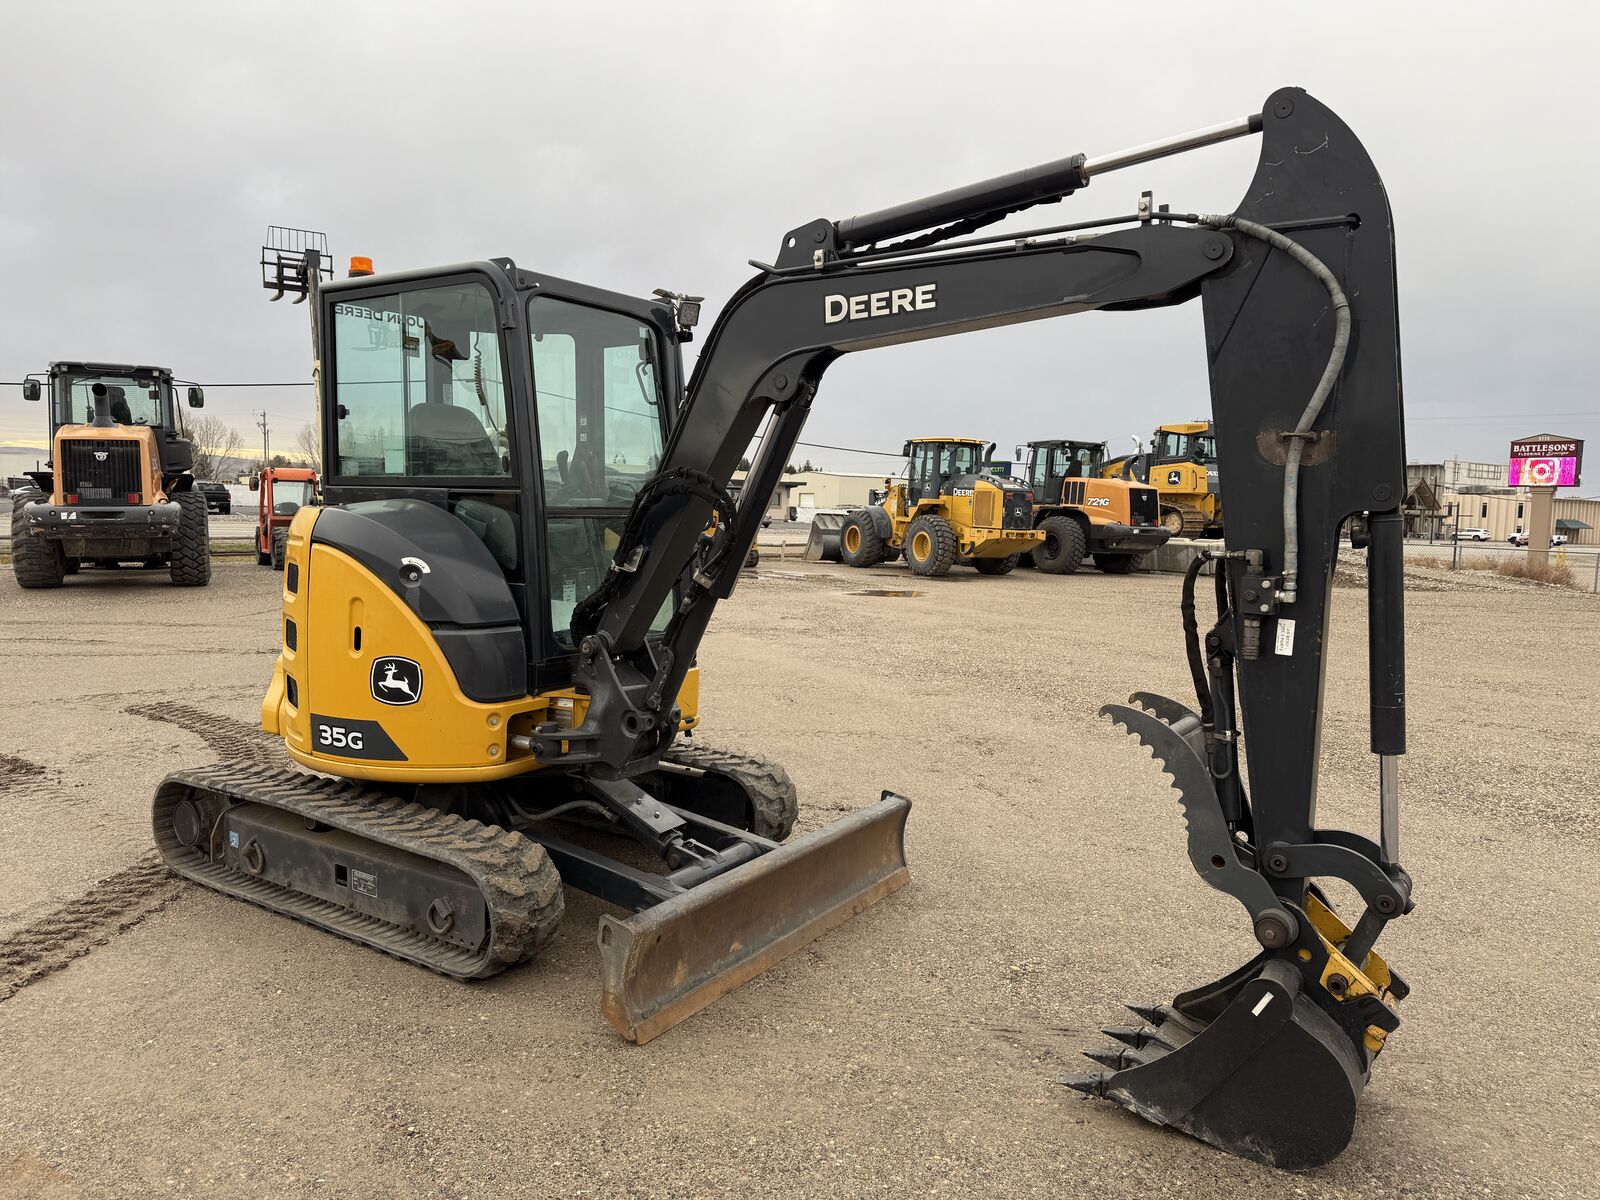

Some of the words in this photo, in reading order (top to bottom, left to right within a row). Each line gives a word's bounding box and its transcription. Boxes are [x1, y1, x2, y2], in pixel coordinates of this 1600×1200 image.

[825, 284, 936, 323] DEERE
[1513, 443, 1576, 452] BATTLESON'S
[1087, 497, 1110, 506] 721G
[319, 724, 363, 750] 35G
